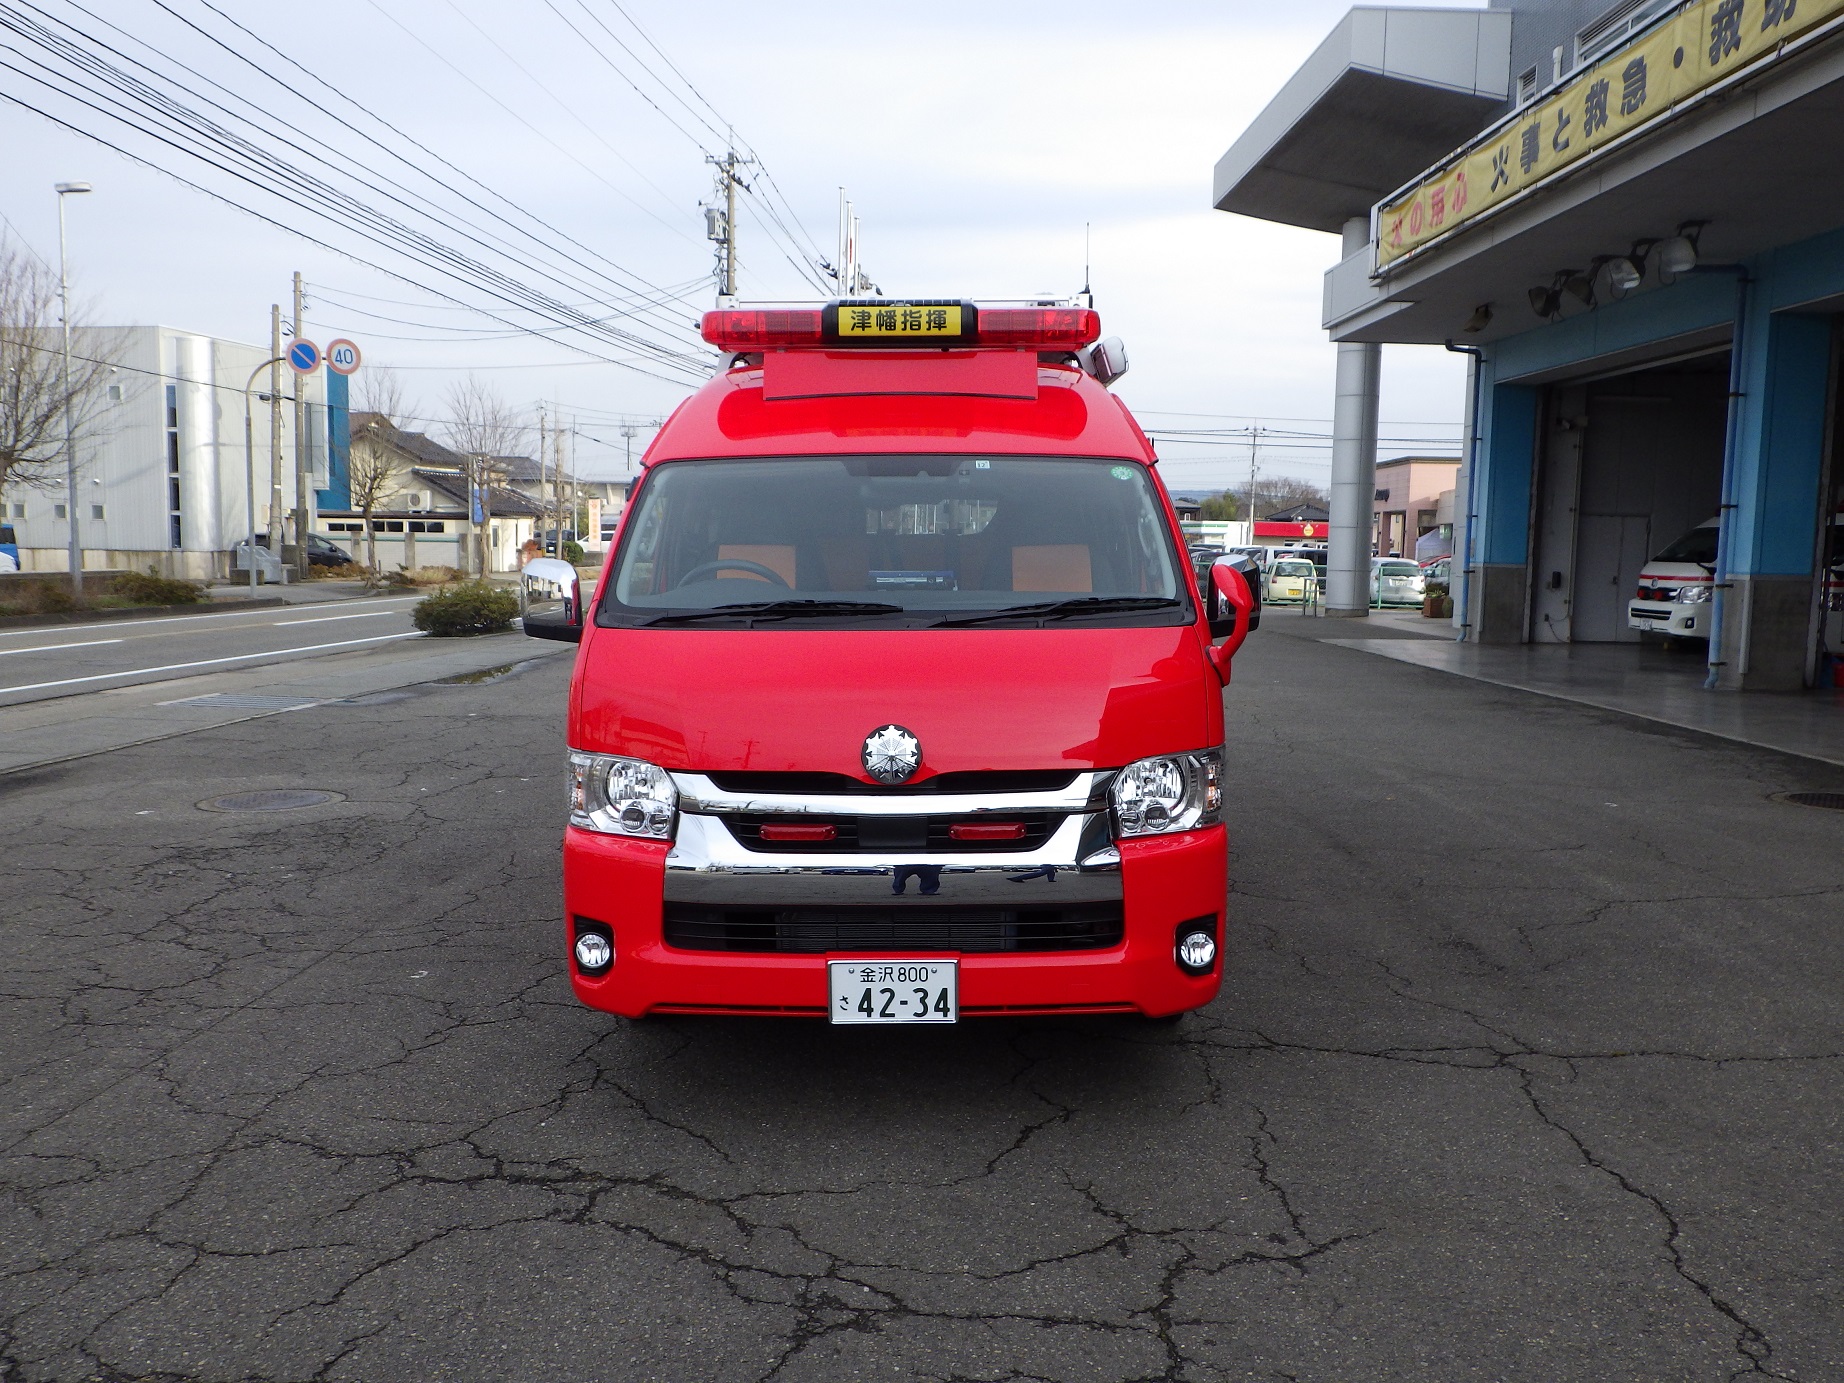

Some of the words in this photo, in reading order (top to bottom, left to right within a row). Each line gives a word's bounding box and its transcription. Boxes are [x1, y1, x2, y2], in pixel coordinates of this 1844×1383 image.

[850, 309, 948, 331] 津幡指揮
[335, 348, 353, 364] 40
[859, 966, 929, 983] 金沢800
[839, 995, 849, 1011] さ
[857, 987, 951, 1018] 42-34
